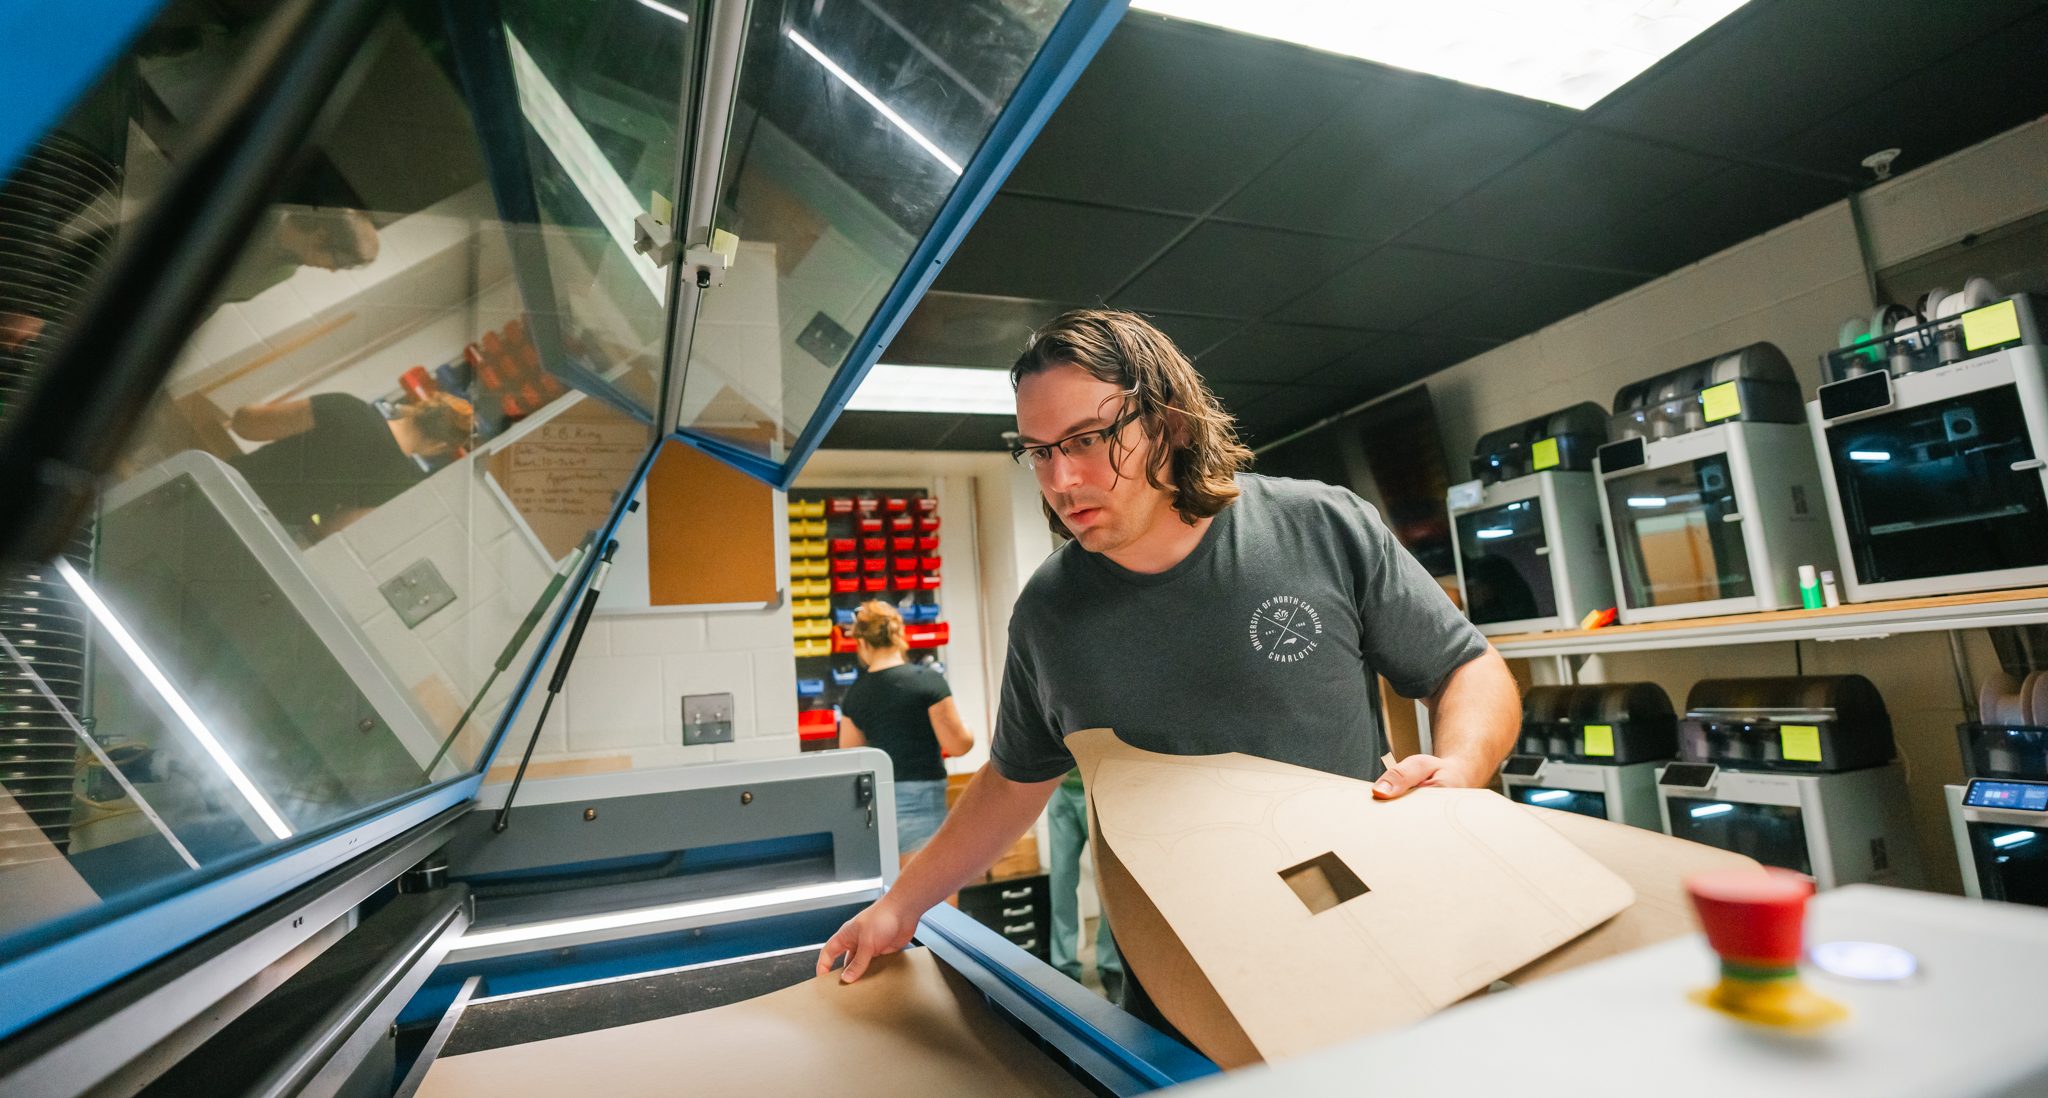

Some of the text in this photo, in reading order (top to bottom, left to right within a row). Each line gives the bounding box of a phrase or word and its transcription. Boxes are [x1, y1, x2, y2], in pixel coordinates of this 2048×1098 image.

[1249, 595, 1322, 651] UNIVERSITY OF NORTH CAROLINA
[1268, 640, 1318, 662] CHARLOTTE
